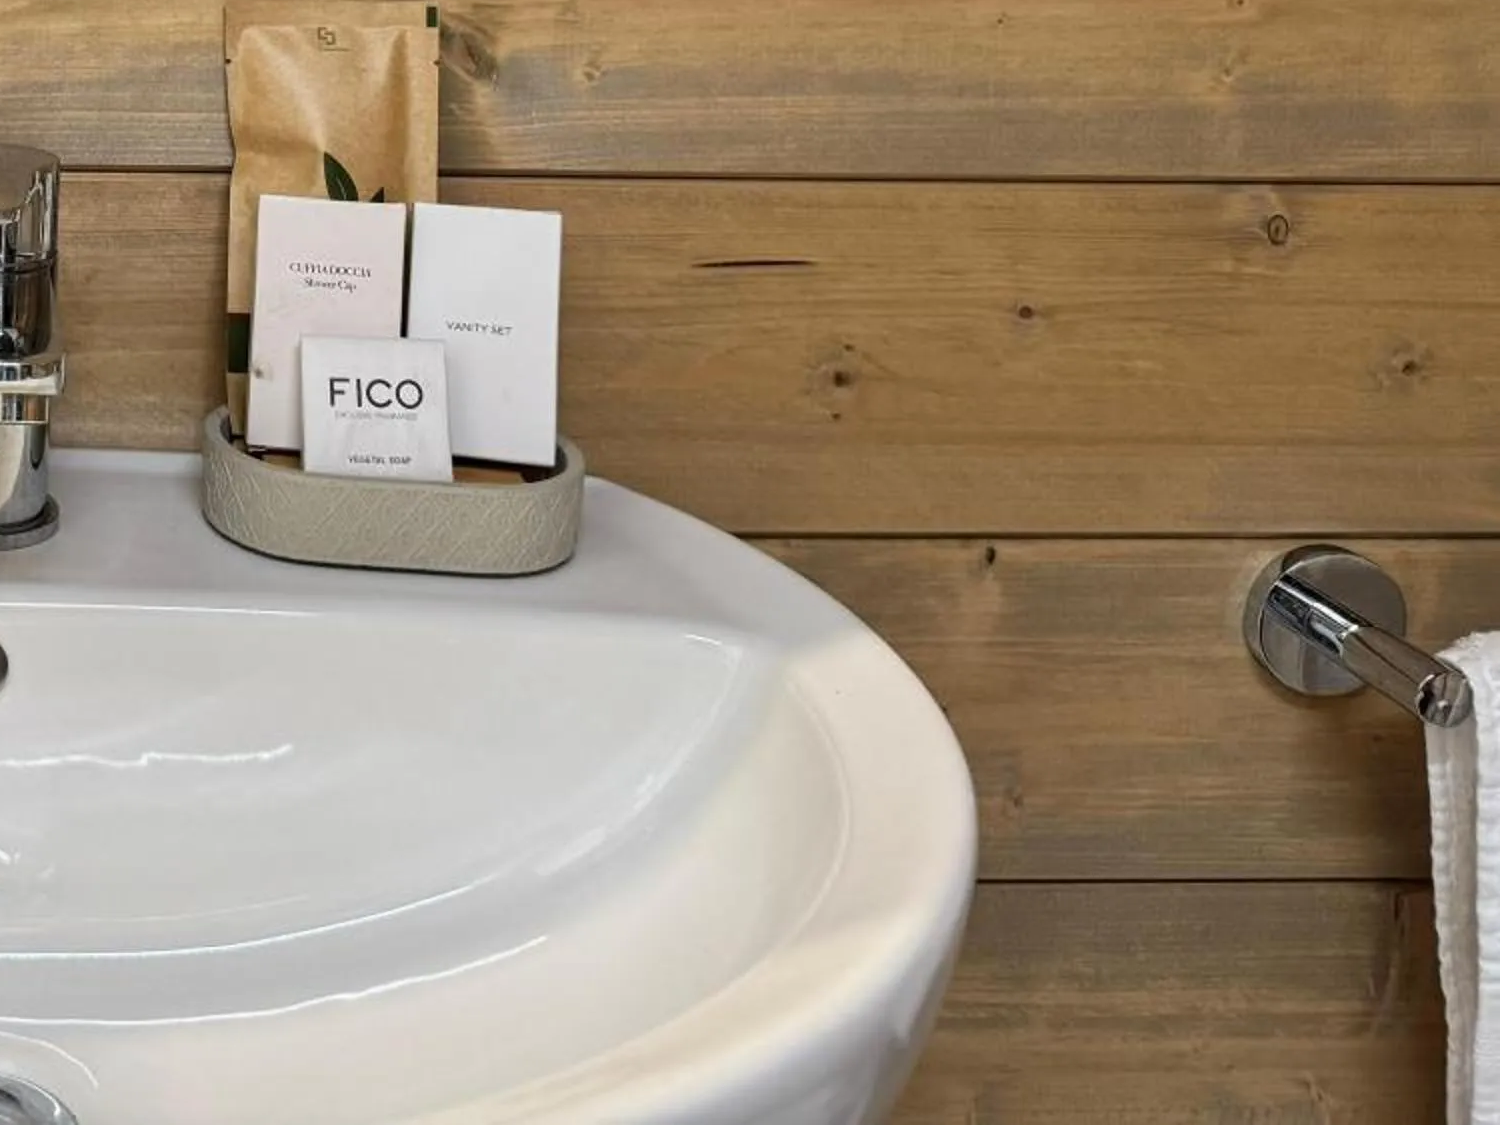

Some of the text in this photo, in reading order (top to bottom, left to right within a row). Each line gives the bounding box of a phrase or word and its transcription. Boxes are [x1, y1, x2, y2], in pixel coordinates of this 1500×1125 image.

[445, 320, 513, 336] VANITY SET
[329, 377, 424, 410] FICO
